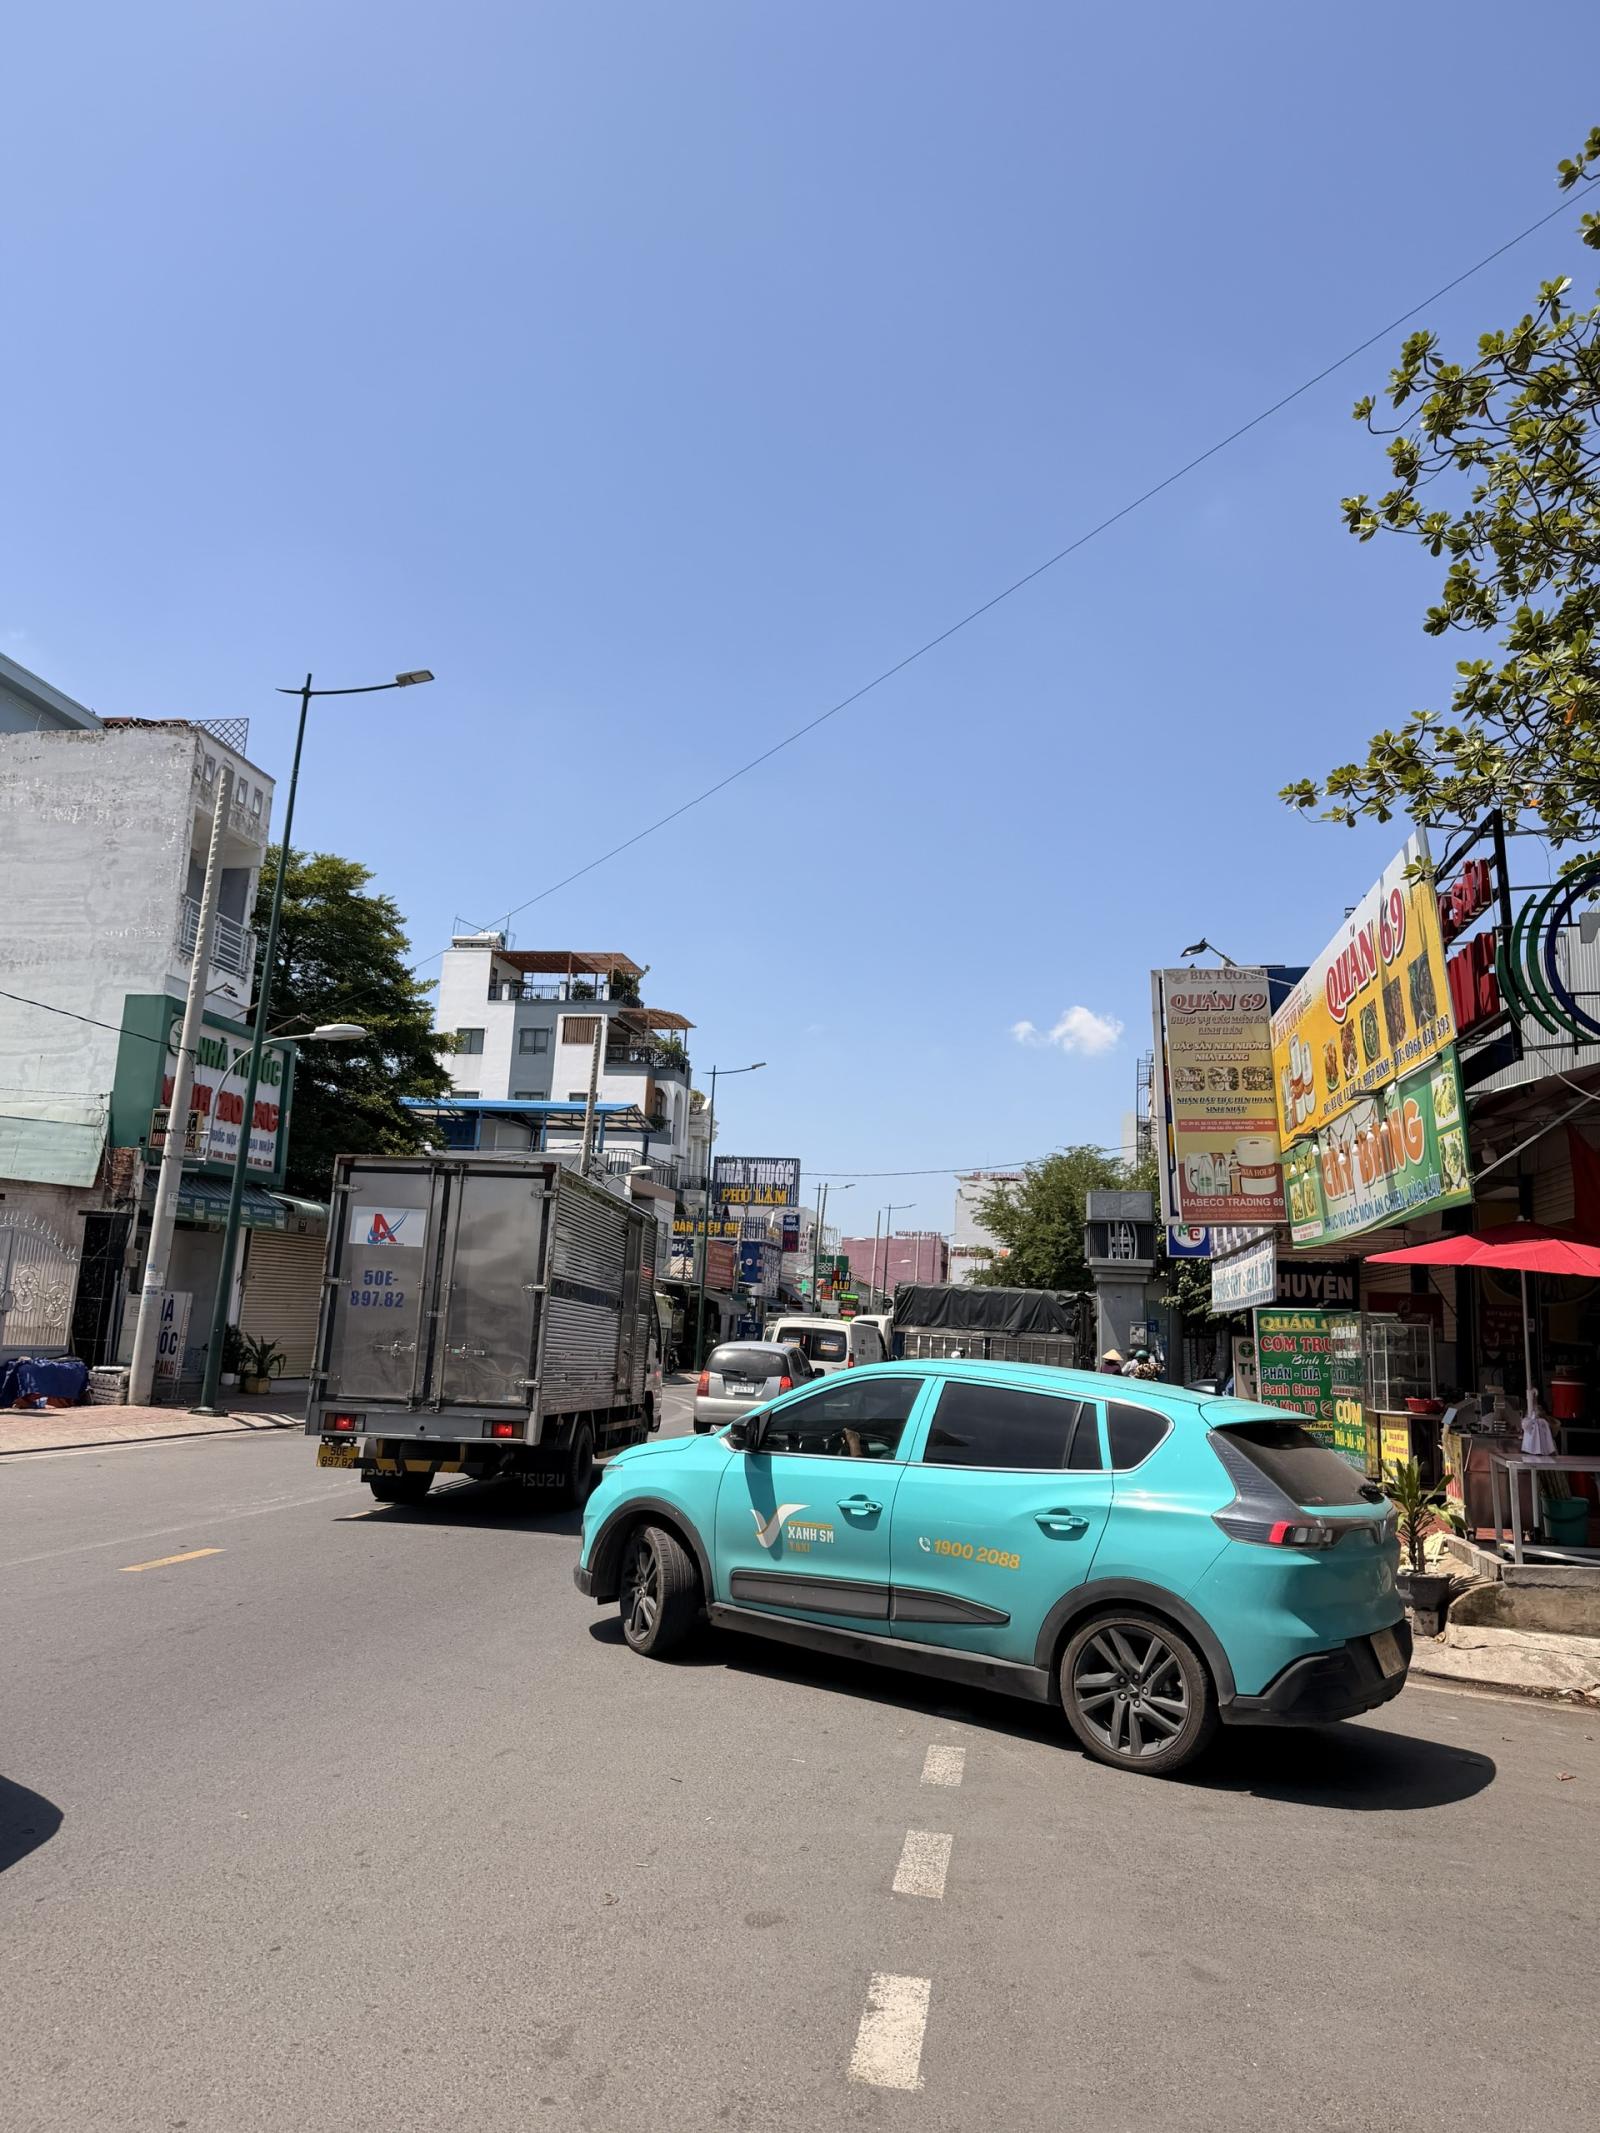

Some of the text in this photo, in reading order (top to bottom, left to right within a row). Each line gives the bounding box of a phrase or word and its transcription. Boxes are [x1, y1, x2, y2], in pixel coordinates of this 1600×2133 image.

[1325, 886, 1405, 1025] QUÁN 69
[1170, 990, 1236, 1014] QUÁN
[1239, 993, 1267, 1011] 69
[196, 1037, 228, 1071] NHÀ
[1218, 1053, 1249, 1061] TRANG
[717, 1158, 795, 1185] NHÀ THUỐC
[1183, 1198, 1284, 1207] HABECO TRADING 89
[364, 1269, 399, 1285] 50E-
[350, 1290, 404, 1308] 897.82
[1259, 1313, 1316, 1330] QUÁN
[1260, 1333, 1296, 1352] CƠM
[1335, 1397, 1362, 1426] CƠM
[330, 1446, 347, 1457] 50E
[321, 1456, 353, 1468] 897.82
[522, 1473, 566, 1488] ISUZU
[788, 1526, 834, 1543] XANH SM
[934, 1539, 1021, 1570] 1900 2088
